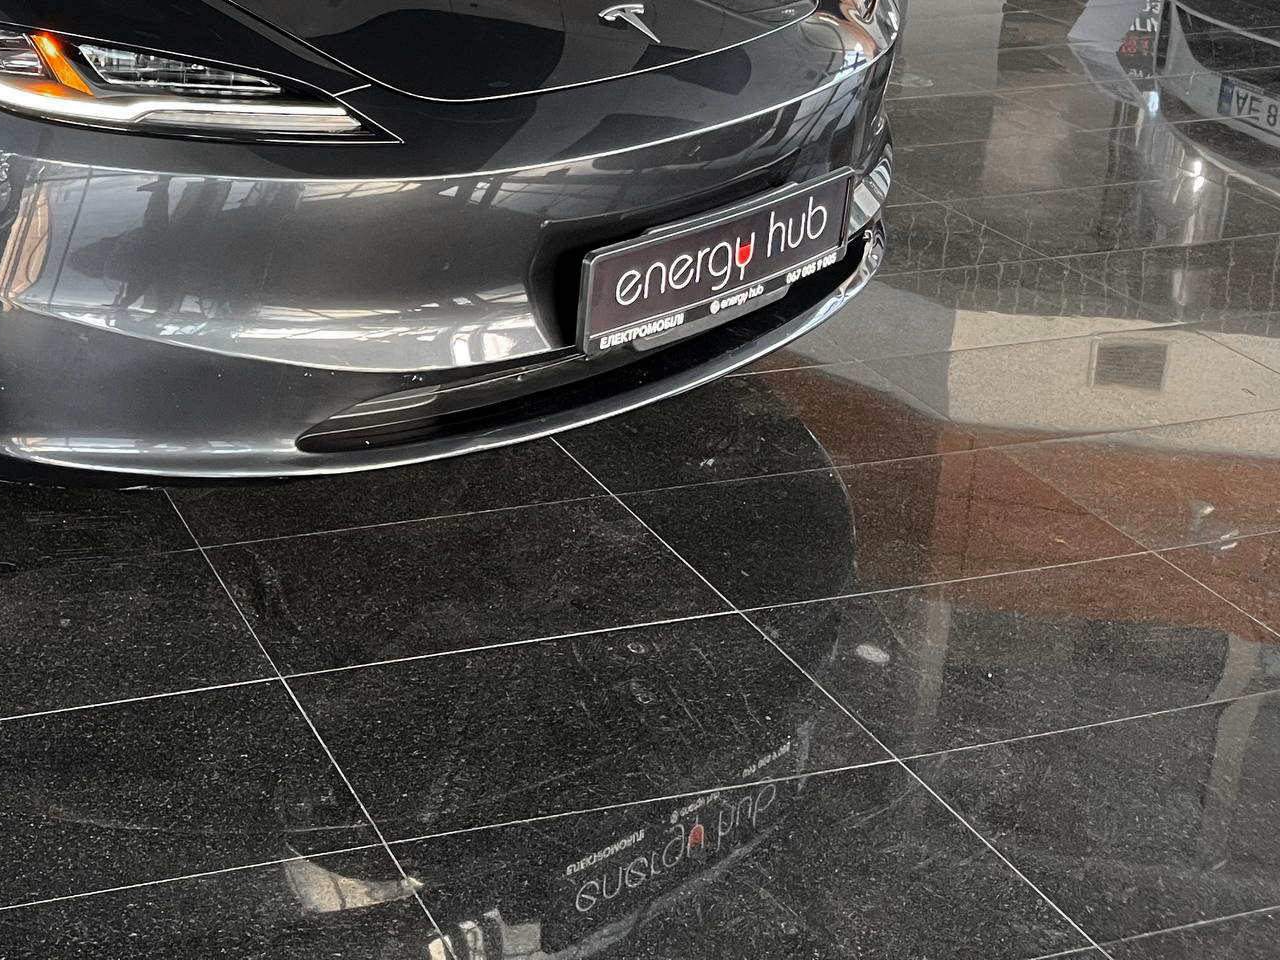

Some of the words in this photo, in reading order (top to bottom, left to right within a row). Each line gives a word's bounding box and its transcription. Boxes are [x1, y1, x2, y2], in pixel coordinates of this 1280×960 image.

[616, 231, 755, 306] energy
[766, 196, 827, 258] hub
[786, 268, 802, 284] 067
[801, 261, 817, 278] 005
[822, 251, 837, 268] 005
[720, 290, 749, 309] energy
[748, 284, 765, 298] hub
[600, 312, 685, 350] ЕЛЕКТРОМОБІЛІ
